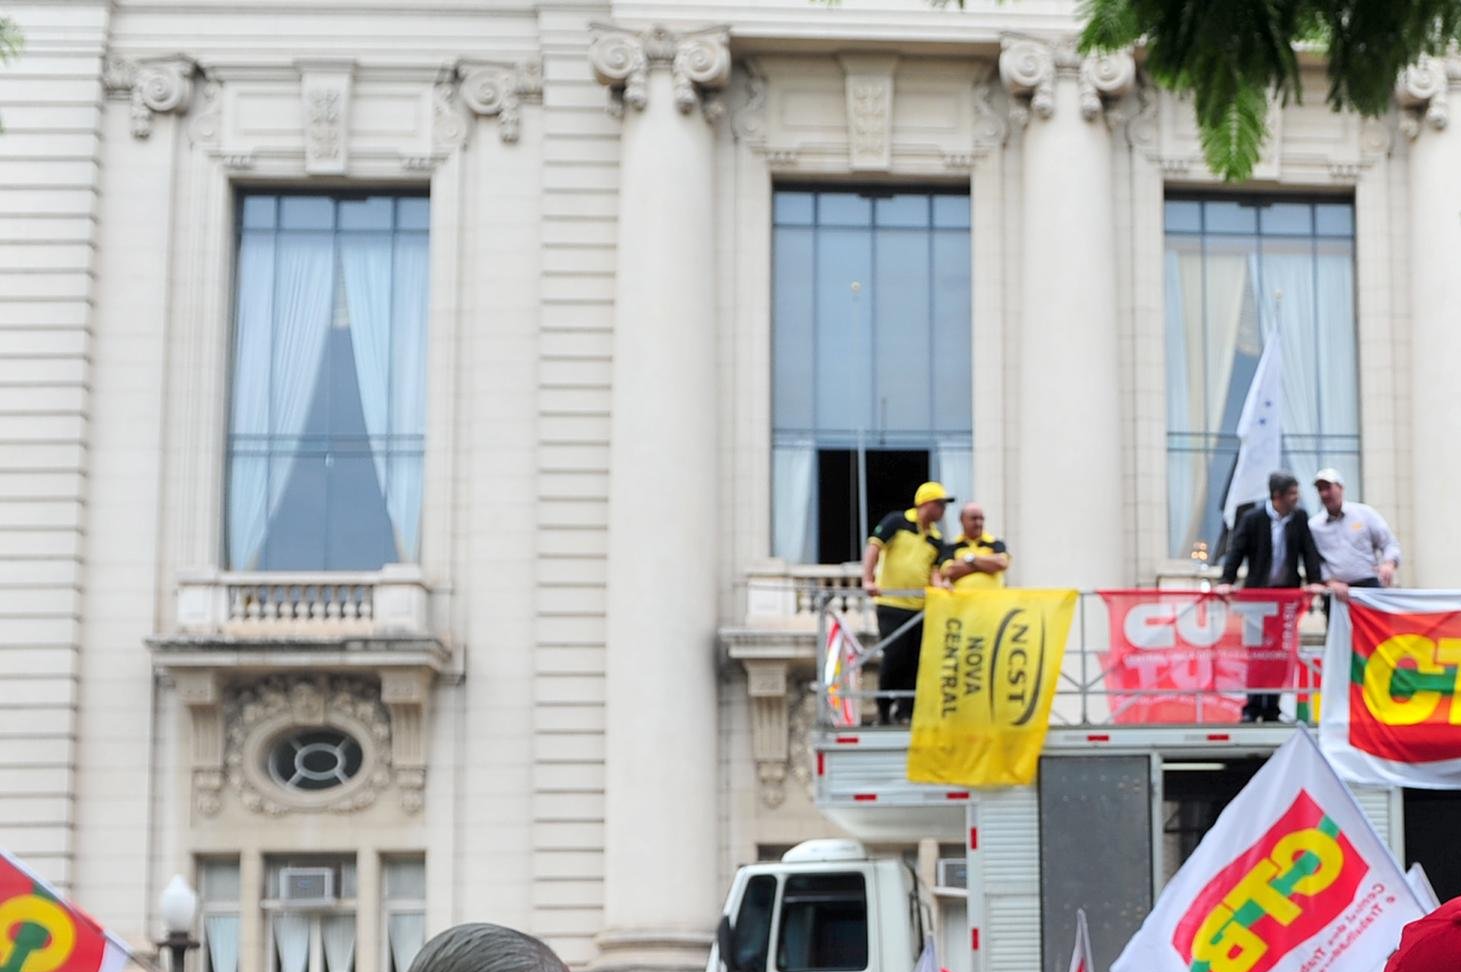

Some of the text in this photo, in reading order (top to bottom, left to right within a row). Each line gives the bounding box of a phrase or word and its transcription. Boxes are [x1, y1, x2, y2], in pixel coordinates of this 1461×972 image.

[1123, 599, 1279, 649] CUT
[941, 618, 962, 718] CENTRAL
[963, 636, 984, 696] NOVA
[1007, 622, 1029, 706] NCST
